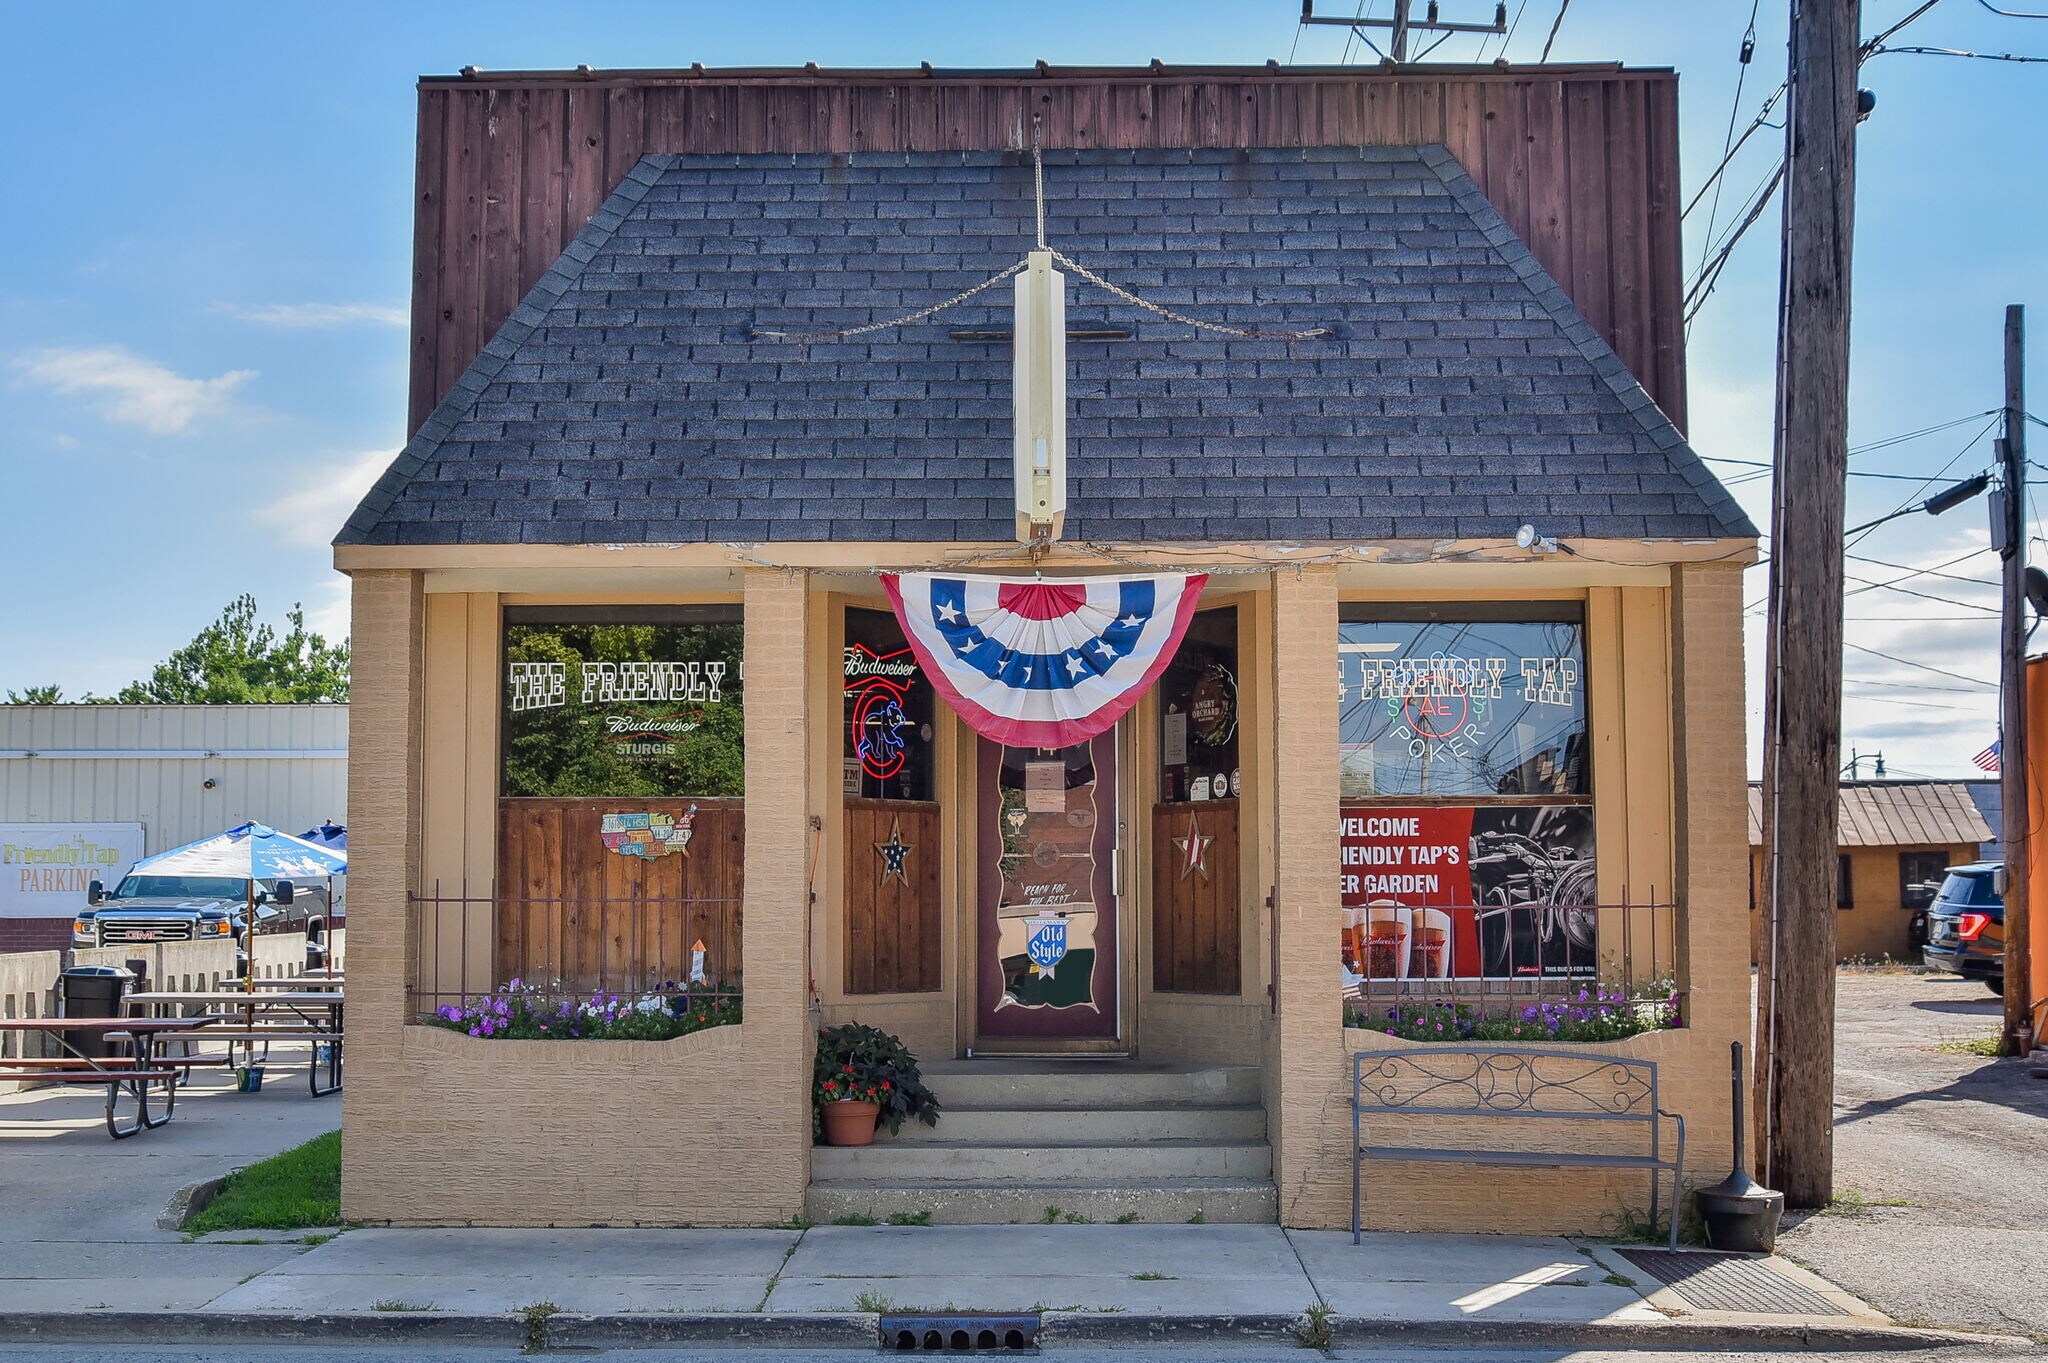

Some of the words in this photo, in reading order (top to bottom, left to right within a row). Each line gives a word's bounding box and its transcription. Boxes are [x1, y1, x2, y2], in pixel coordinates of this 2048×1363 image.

[844, 653, 917, 676] Budweiser
[510, 662, 566, 712] THE
[582, 662, 726, 703] FRIENDLY
[1360, 658, 1507, 700] FRIENDLY
[1521, 658, 1578, 707] TAP
[1191, 707, 1220, 719] ORCHARD
[1195, 700, 1215, 710] ANGRY
[606, 715, 700, 733] Budweiser
[615, 743, 676, 755] STURGIS
[1389, 723, 1486, 763] POKER
[844, 769, 858, 781] TM
[84, 843, 120, 866] Tap
[1342, 846, 1404, 865] IENDLY
[1408, 845, 1460, 865] TAP'S
[1024, 885, 1051, 896] REACH
[1051, 883, 1068, 894] FOR
[1340, 875, 1360, 894] ER
[1365, 874, 1439, 894] GARDEN
[1029, 897, 1045, 906] THE
[1045, 894, 1071, 906] BEST
[125, 930, 164, 940] GMC
[1041, 926, 1064, 943] Old
[1031, 940, 1063, 964] Style
[1415, 943, 1442, 951] dweiser
[893, 1320, 919, 1329] EAST
